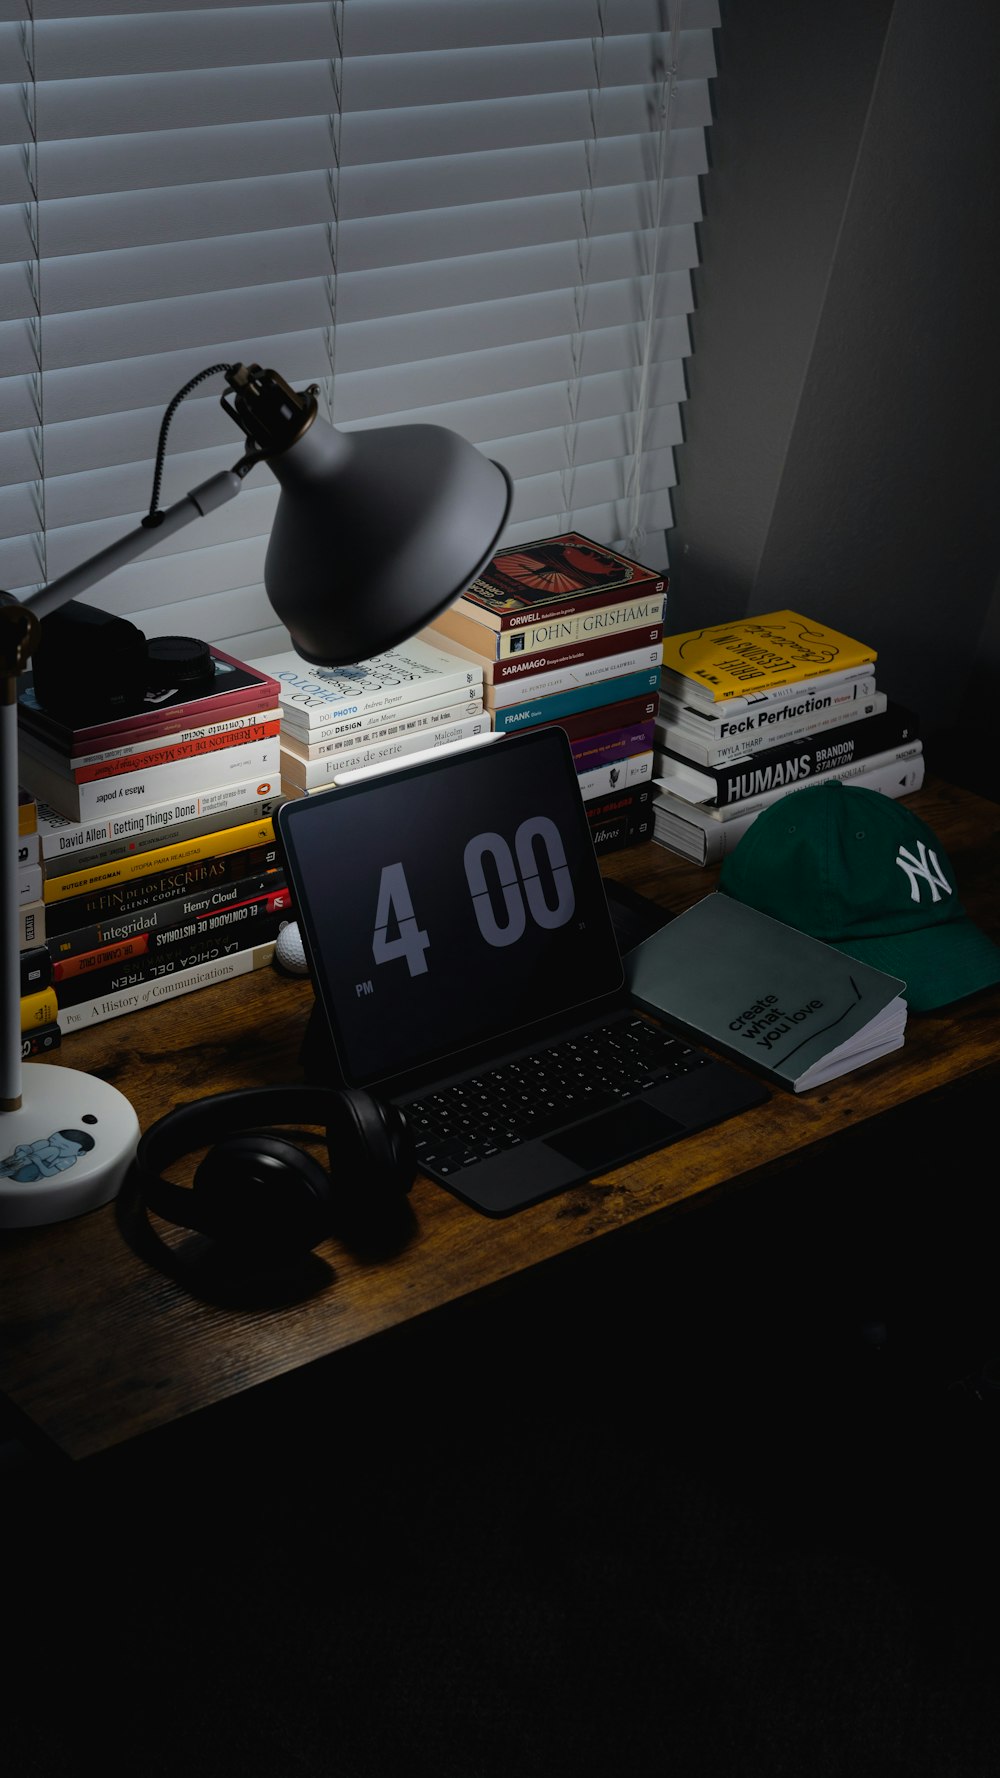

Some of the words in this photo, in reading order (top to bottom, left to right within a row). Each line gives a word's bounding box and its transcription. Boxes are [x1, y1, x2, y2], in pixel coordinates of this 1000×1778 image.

[509, 612, 541, 627] ORWELL
[531, 622, 572, 647] JOHN
[583, 603, 649, 631] GRISHAM
[709, 634, 743, 646] IN
[726, 642, 797, 673] LESSONS
[502, 658, 546, 676] SARAMAGO
[529, 683, 547, 691] PUNTO
[585, 667, 609, 677] MALCOLM
[610, 660, 636, 671] GLADWELL
[712, 659, 766, 681] BRIEF
[772, 689, 793, 698] WHITE
[333, 706, 358, 719] PHOTO
[364, 701, 384, 711] Andrew
[384, 695, 403, 706] Paynter
[247, 716, 257, 726] El
[335, 721, 362, 734] DESIGN
[367, 717, 379, 726] Alan
[380, 713, 396, 722] Moore
[504, 711, 530, 724] FRANK
[720, 717, 755, 738] Feck
[758, 696, 832, 727] Perfuction
[834, 695, 851, 704] Victore
[181, 728, 205, 743] Social
[208, 719, 246, 734] Contrato
[253, 725, 266, 735] LA
[326, 743, 334, 751] NOT
[334, 741, 343, 750] HOW
[343, 738, 354, 748] GOOD
[379, 728, 387, 738] HOW
[387, 726, 398, 735] GOOD
[406, 721, 416, 730] WANT
[417, 719, 422, 727] TO
[431, 714, 439, 723] Paul
[434, 728, 463, 741] Malcolm
[209, 728, 251, 746] REBELION
[717, 744, 740, 757] TWYLA
[741, 737, 763, 750] THARP
[776, 731, 793, 741] CREATIVE
[178, 745, 193, 757] LAS
[195, 741, 207, 752] DE
[895, 748, 917, 760] TASCHEN
[143, 748, 175, 765] MASAS
[326, 756, 360, 772] Fueras
[363, 750, 376, 762] de
[378, 744, 402, 757] serie
[815, 752, 854, 772] STANTON
[727, 754, 811, 803] HUMANS
[815, 740, 855, 762] BRANDON
[96, 790, 117, 803] poder
[119, 788, 124, 797] y
[125, 785, 145, 796] Masa
[222, 788, 246, 799] stress-free
[202, 801, 228, 813] productivity
[59, 831, 84, 850] David
[86, 828, 107, 843] Allen
[113, 818, 144, 836] Getting
[145, 810, 173, 826] Things
[175, 804, 195, 818] Done
[594, 829, 620, 843] libros
[61, 880, 88, 891] RUTGER
[89, 871, 121, 884] BREGMAN
[131, 861, 152, 872] UTOPIA
[153, 857, 169, 867] PARA
[170, 848, 201, 862] REALISTAS
[86, 903, 97, 912] EL
[99, 892, 125, 910] FIN
[126, 888, 138, 898] DE
[141, 883, 157, 894] LOS
[160, 861, 226, 892] ESCRIBAS
[120, 898, 149, 912] GLENN
[152, 886, 187, 902] COOPER
[372, 861, 431, 978] 4
[463, 815, 577, 948] 00
[96, 912, 158, 943] integridad
[183, 899, 210, 914] Henry
[211, 888, 238, 904] Cloud
[209, 908, 247, 929] CONTADOR
[249, 904, 258, 915] EL
[156, 924, 196, 947] HISTORIAS
[199, 921, 208, 933] DE
[98, 948, 122, 964] CAMILO
[224, 941, 239, 953] LA
[79, 957, 96, 970] CRUZ
[180, 948, 219, 967] CHICA
[150, 962, 175, 977] DEL
[112, 971, 145, 989] TREN
[355, 979, 374, 998] PM
[66, 1014, 82, 1025] POE
[91, 1005, 100, 1018] A
[102, 995, 140, 1014] History
[142, 991, 152, 1002] of
[152, 964, 234, 997] Communications
[728, 994, 779, 1032] create
[741, 1007, 786, 1039] what
[756, 1022, 792, 1051] you
[784, 999, 824, 1025] love
